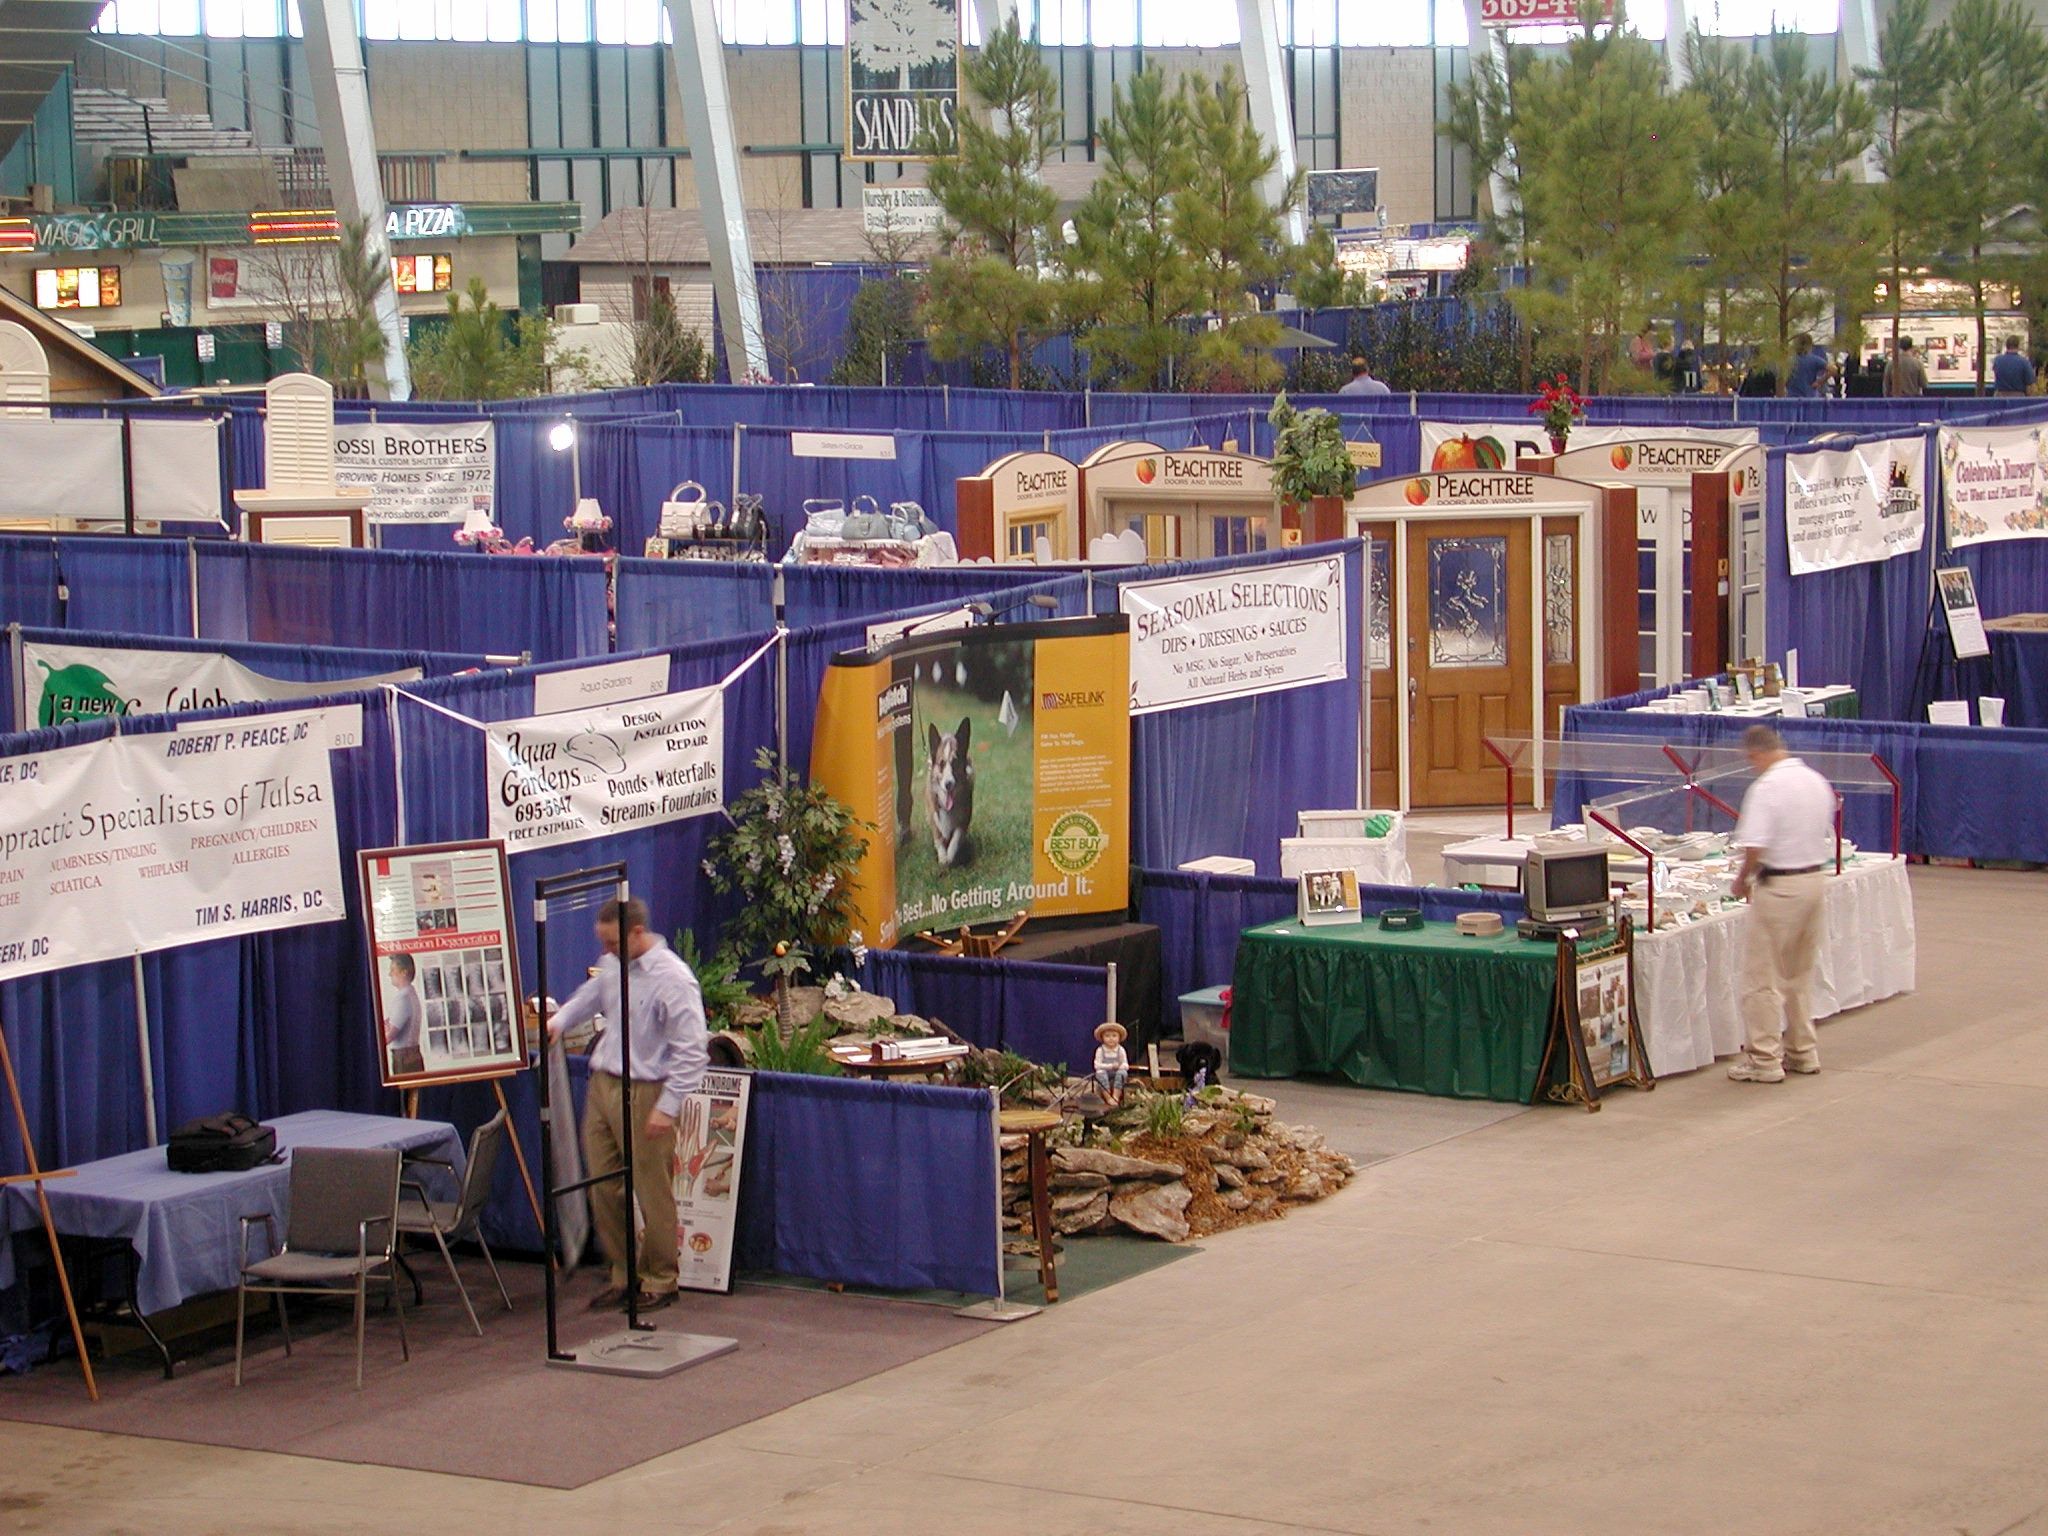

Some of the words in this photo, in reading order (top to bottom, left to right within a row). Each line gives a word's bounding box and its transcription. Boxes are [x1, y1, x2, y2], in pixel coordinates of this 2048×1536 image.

[34, 220, 97, 247] MAGIC
[107, 218, 160, 243] GRILL
[385, 211, 399, 233] A
[405, 208, 455, 235] PIZZA
[384, 437, 487, 456] BROTHERS
[379, 458, 409, 466] CUSTOM
[412, 457, 448, 466] SHUTTER
[1164, 456, 1243, 479] PEACHTREE
[381, 473, 421, 483] HOMES
[425, 471, 455, 483] SINCE
[462, 469, 491, 481] 1972
[1017, 470, 1067, 494] PEACHTREE
[1437, 475, 1534, 498] PEACHTREE
[428, 485, 467, 495] Oklahoma
[1437, 498, 1467, 506] DOORS
[1138, 588, 1227, 641] SEASONAL
[1231, 583, 1328, 614] SELECTIONS
[1162, 636, 1187, 654] DIPS
[1200, 625, 1258, 649] DRESSINGS
[1270, 617, 1307, 638] SAUCES
[1173, 663, 1183, 675] No
[1185, 659, 1205, 672] MSG,
[1208, 658, 1219, 671] No
[1220, 655, 1241, 670] Sugar,
[1244, 651, 1255, 665] No
[1256, 646, 1297, 662] Preservatives
[580, 679, 601, 692] Aqua
[602, 676, 633, 690] Gardens
[1187, 676, 1199, 689] All
[1201, 672, 1227, 687] Natural
[1228, 669, 1249, 683] Herbs
[1250, 668, 1263, 679] and
[1264, 665, 1284, 679] Spices
[61, 696, 72, 711] a
[79, 695, 116, 714] new
[1058, 690, 1104, 706] SAFELINK
[622, 712, 662, 728] DESIGN
[633, 718, 706, 742] INSTALLATION
[167, 737, 222, 757] ROBERT
[224, 734, 238, 751] P.
[241, 729, 291, 749] PEACE,
[293, 722, 310, 740] DC
[335, 733, 354, 747] 810
[666, 735, 708, 752] REPAIR
[20, 761, 38, 780] DC
[607, 775, 649, 798] Ponds
[656, 761, 717, 788] Waterfalls
[501, 764, 581, 808] Gardens
[79, 793, 215, 841] Specialists
[224, 782, 248, 821] of
[256, 775, 323, 812] Tulsa
[515, 795, 573, 823] 695-5647
[600, 802, 656, 826] Streams
[661, 787, 718, 815] Fountains
[190, 818, 318, 851] PREGNANCY/CHILDREN
[508, 828, 536, 842] FREE
[1050, 838, 1077, 850] BEST
[1079, 837, 1101, 849] BUY
[50, 842, 157, 875] NUMBNESS/TINGLING
[232, 845, 290, 865] ALLERGIES
[138, 860, 189, 880] WHIPLASH
[49, 875, 103, 896] SCIATICA
[951, 885, 1001, 911] Getting
[1007, 877, 1067, 900] Around
[195, 905, 219, 927] TIM
[223, 902, 236, 921] S.
[240, 893, 298, 918] HARRIS,
[303, 889, 323, 909] DC
[31, 936, 49, 957] DC
[435, 933, 499, 951] Degeneration
[702, 1075, 742, 1092] SYNDROME
